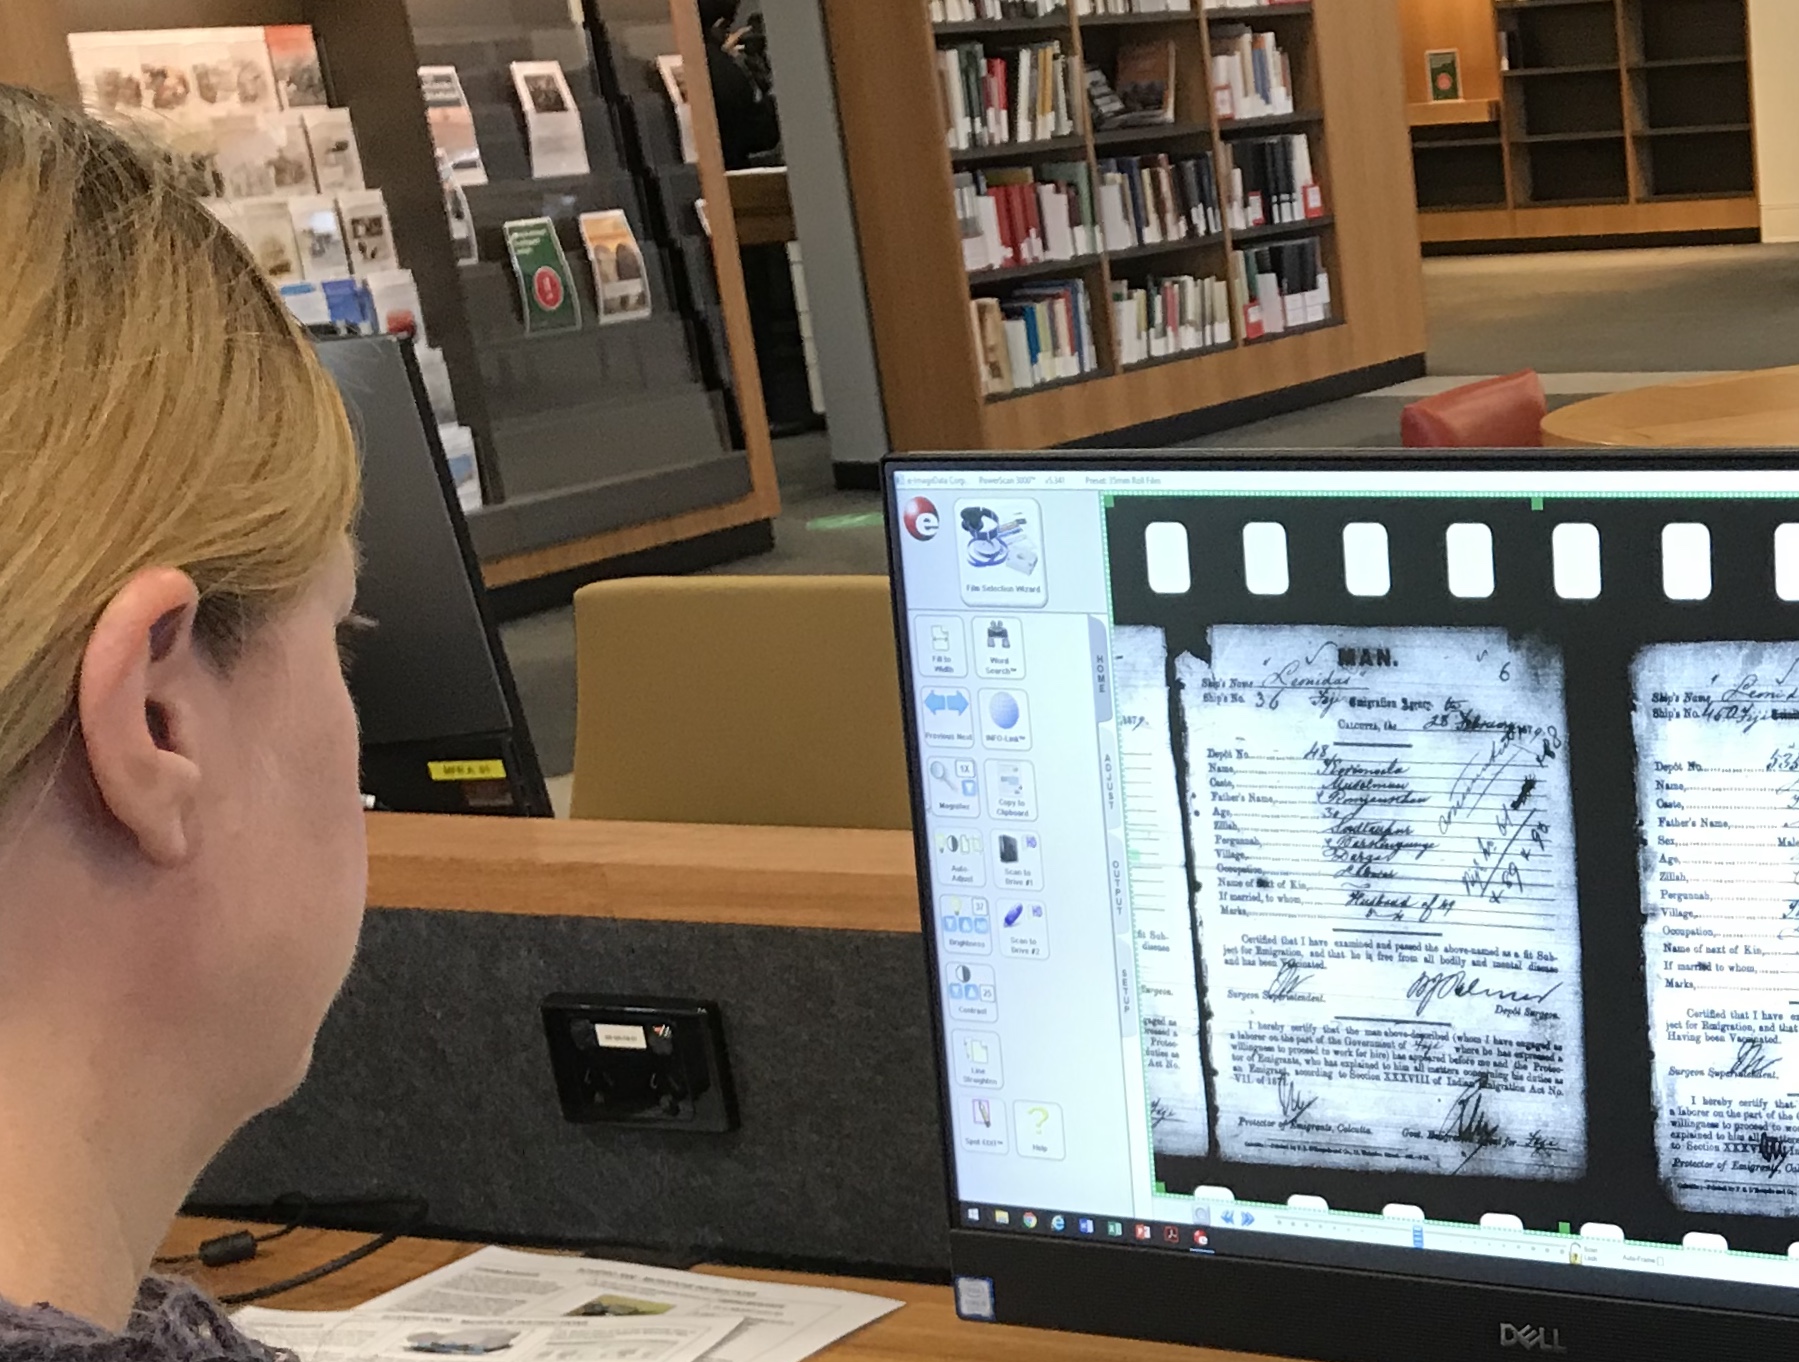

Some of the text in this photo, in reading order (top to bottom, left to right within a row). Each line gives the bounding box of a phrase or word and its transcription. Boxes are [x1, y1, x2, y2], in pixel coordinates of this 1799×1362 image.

[966, 584, 1041, 593] Film Selection Wizard
[990, 656, 1009, 664] Word
[1096, 654, 1106, 694] HOME
[1651, 692, 1680, 705] Ship's
[1652, 708, 1681, 721] Ship's
[1104, 753, 1114, 810] ADJUST
[1655, 780, 1687, 792] Name,
[1657, 817, 1731, 830] Father's Name,
[1657, 835, 1678, 847] Sex,
[1658, 854, 1681, 866] Age,
[1659, 871, 1690, 883] Zillah,
[1112, 860, 1122, 915] OUTPUT
[1660, 889, 1713, 902] Pergunnah,
[1661, 907, 1697, 920] Village,
[1662, 925, 1717, 938] Occupation,
[1663, 943, 1765, 957] Name of next of Kin,
[1663, 960, 1673, 970] If
[1715, 962, 1725, 972] to
[1728, 963, 1758, 974] whom,
[1121, 968, 1130, 1013] SETUP
[1665, 978, 1697, 990] Marks,
[1686, 1008, 1726, 1020] Certified
[1730, 1010, 1750, 1020] that
[1753, 1010, 1759, 1020] I
[1762, 1011, 1783, 1021] have
[1666, 1020, 1683, 1032] ject
[1685, 1020, 1698, 1030] for
[1758, 1022, 1774, 1032] and
[1779, 1023, 1798, 1033] that
[1667, 1032, 1726, 1044] Having been
[1668, 1066, 1705, 1079] Surgeon
[1500, 1322, 1567, 1351] DELL
